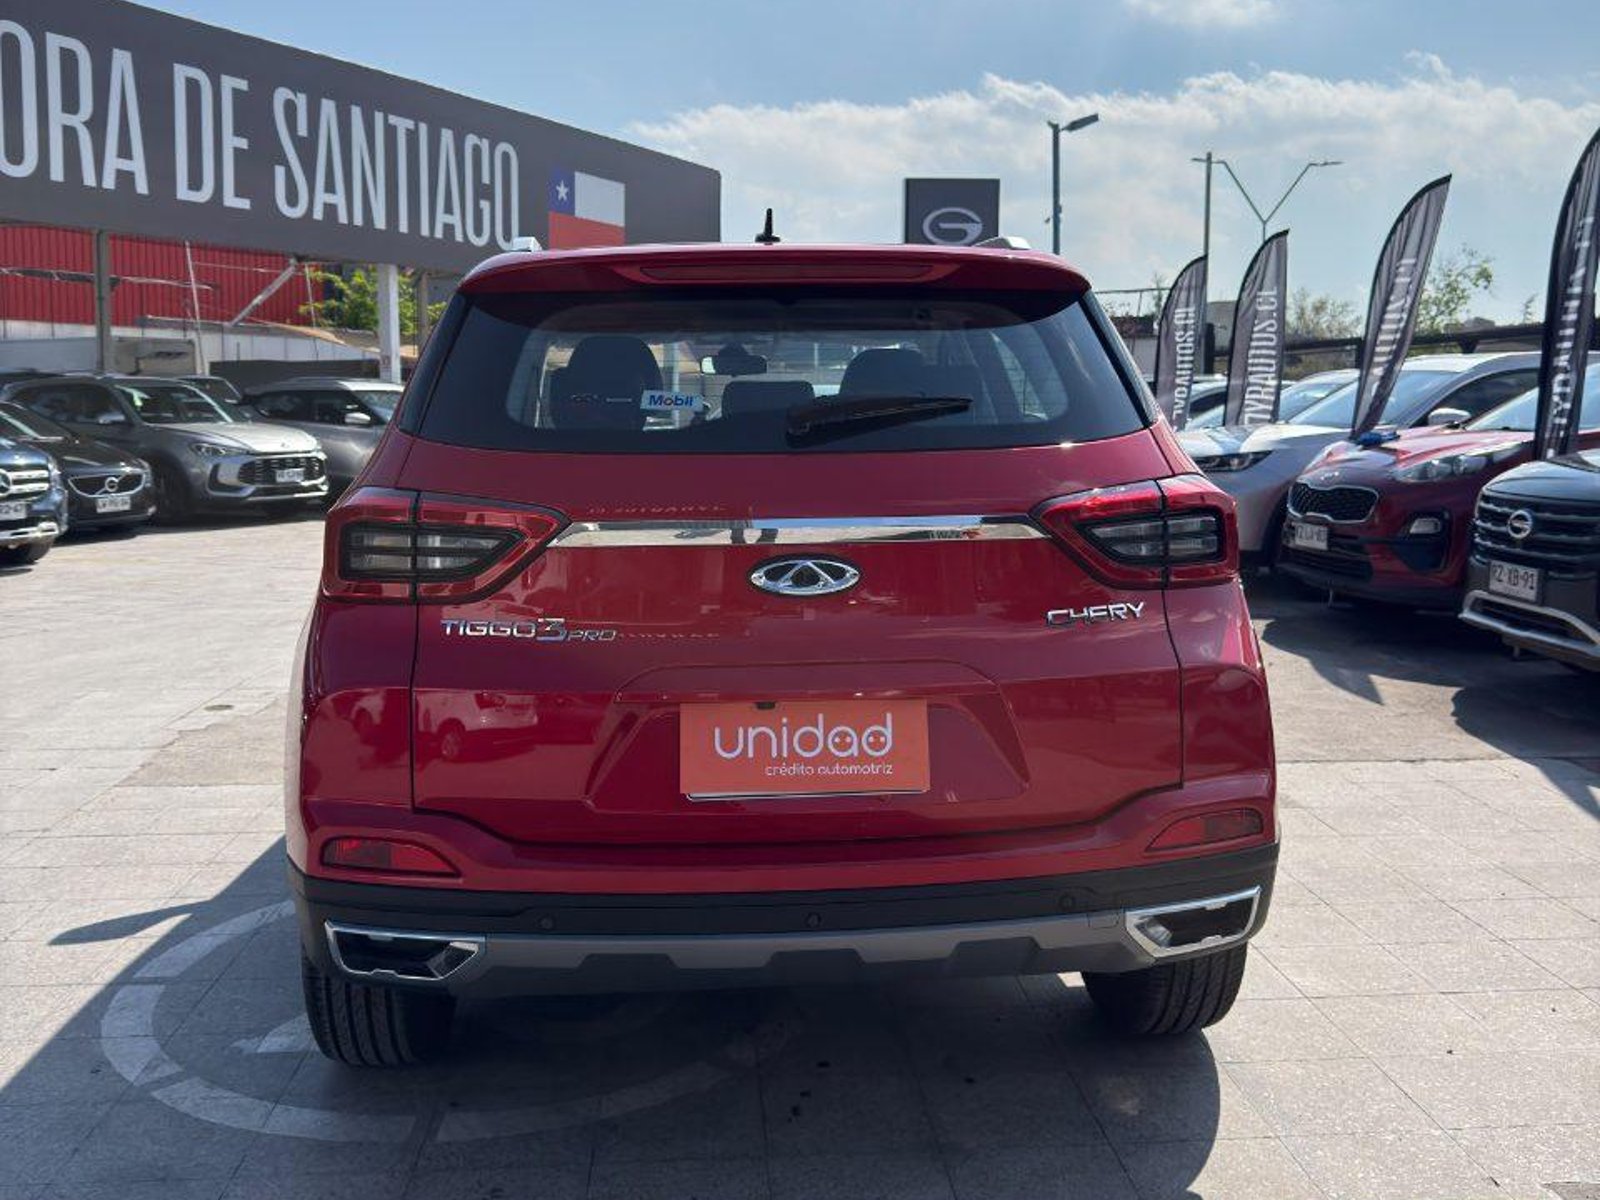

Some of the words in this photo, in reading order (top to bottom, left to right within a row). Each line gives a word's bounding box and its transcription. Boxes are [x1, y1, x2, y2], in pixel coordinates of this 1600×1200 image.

[173, 62, 251, 210] DE
[274, 87, 520, 252] SANTIAGO
[649, 394, 694, 407] Mobil
[1046, 601, 1145, 628] CHERY
[439, 618, 537, 639] TIGGO
[536, 616, 568, 642] 3
[567, 628, 617, 642] PRO
[713, 712, 894, 760] unidad
[764, 762, 815, 777] crédito
[816, 762, 894, 777] automotriz
